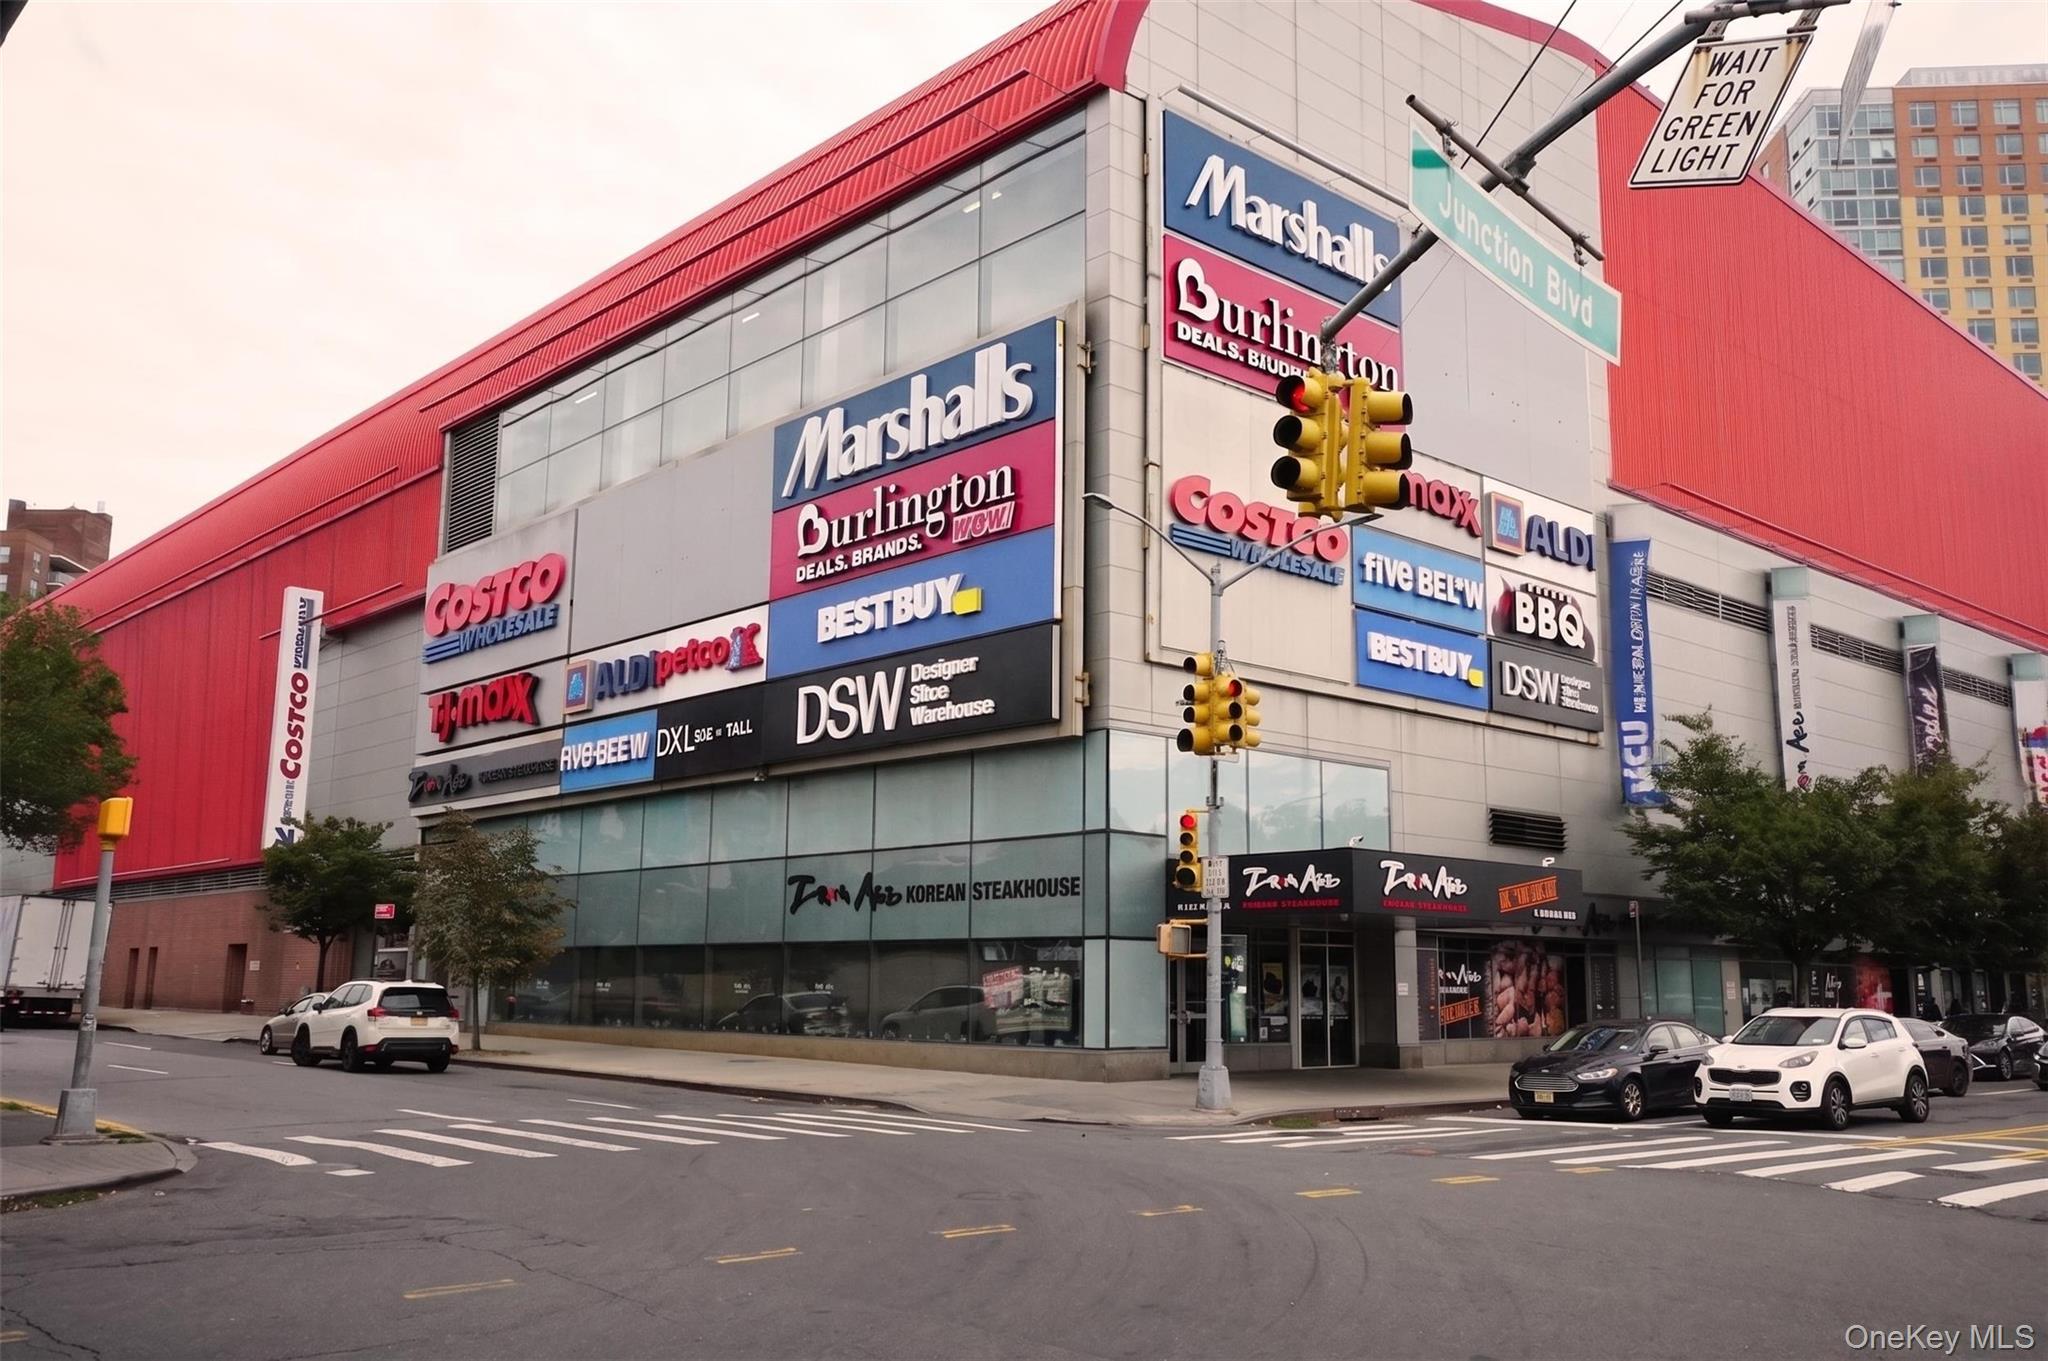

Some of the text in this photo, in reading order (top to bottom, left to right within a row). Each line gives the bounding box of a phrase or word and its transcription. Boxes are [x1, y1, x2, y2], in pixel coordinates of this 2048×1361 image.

[1706, 46, 1779, 78] WAIT
[1693, 79, 1757, 109] FOR
[1663, 110, 1762, 142] GREEN
[1650, 143, 1741, 175] LIGHT
[1438, 182, 1594, 329] Junction Blvd
[1176, 321, 1244, 362] DEALS.
[1177, 257, 1400, 392] Burlinton
[781, 341, 1034, 498] Marshalls
[797, 465, 1015, 557] Burlington
[1170, 475, 1349, 563] COSTCO
[796, 533, 923, 583] DEALS. BRANDS.
[1230, 536, 1346, 586] WHOLESALE
[1526, 514, 1597, 572] ALDI
[424, 552, 567, 638] COSTCO
[1361, 551, 1413, 593] five
[458, 602, 560, 656] WHOLESALE
[1514, 590, 1586, 649] BBQ
[593, 650, 656, 701] ALDI
[654, 636, 730, 688] petco
[911, 656, 980, 683] Designer
[1502, 660, 1560, 705] DSW
[279, 671, 310, 780] COSTCO
[796, 666, 906, 746] DSW
[909, 698, 996, 727] Warehouse
[655, 724, 696, 758] DXL
[725, 718, 753, 738] TALL
[906, 882, 966, 904] KOREAN
[972, 876, 1081, 901] STEAKHOUSE
